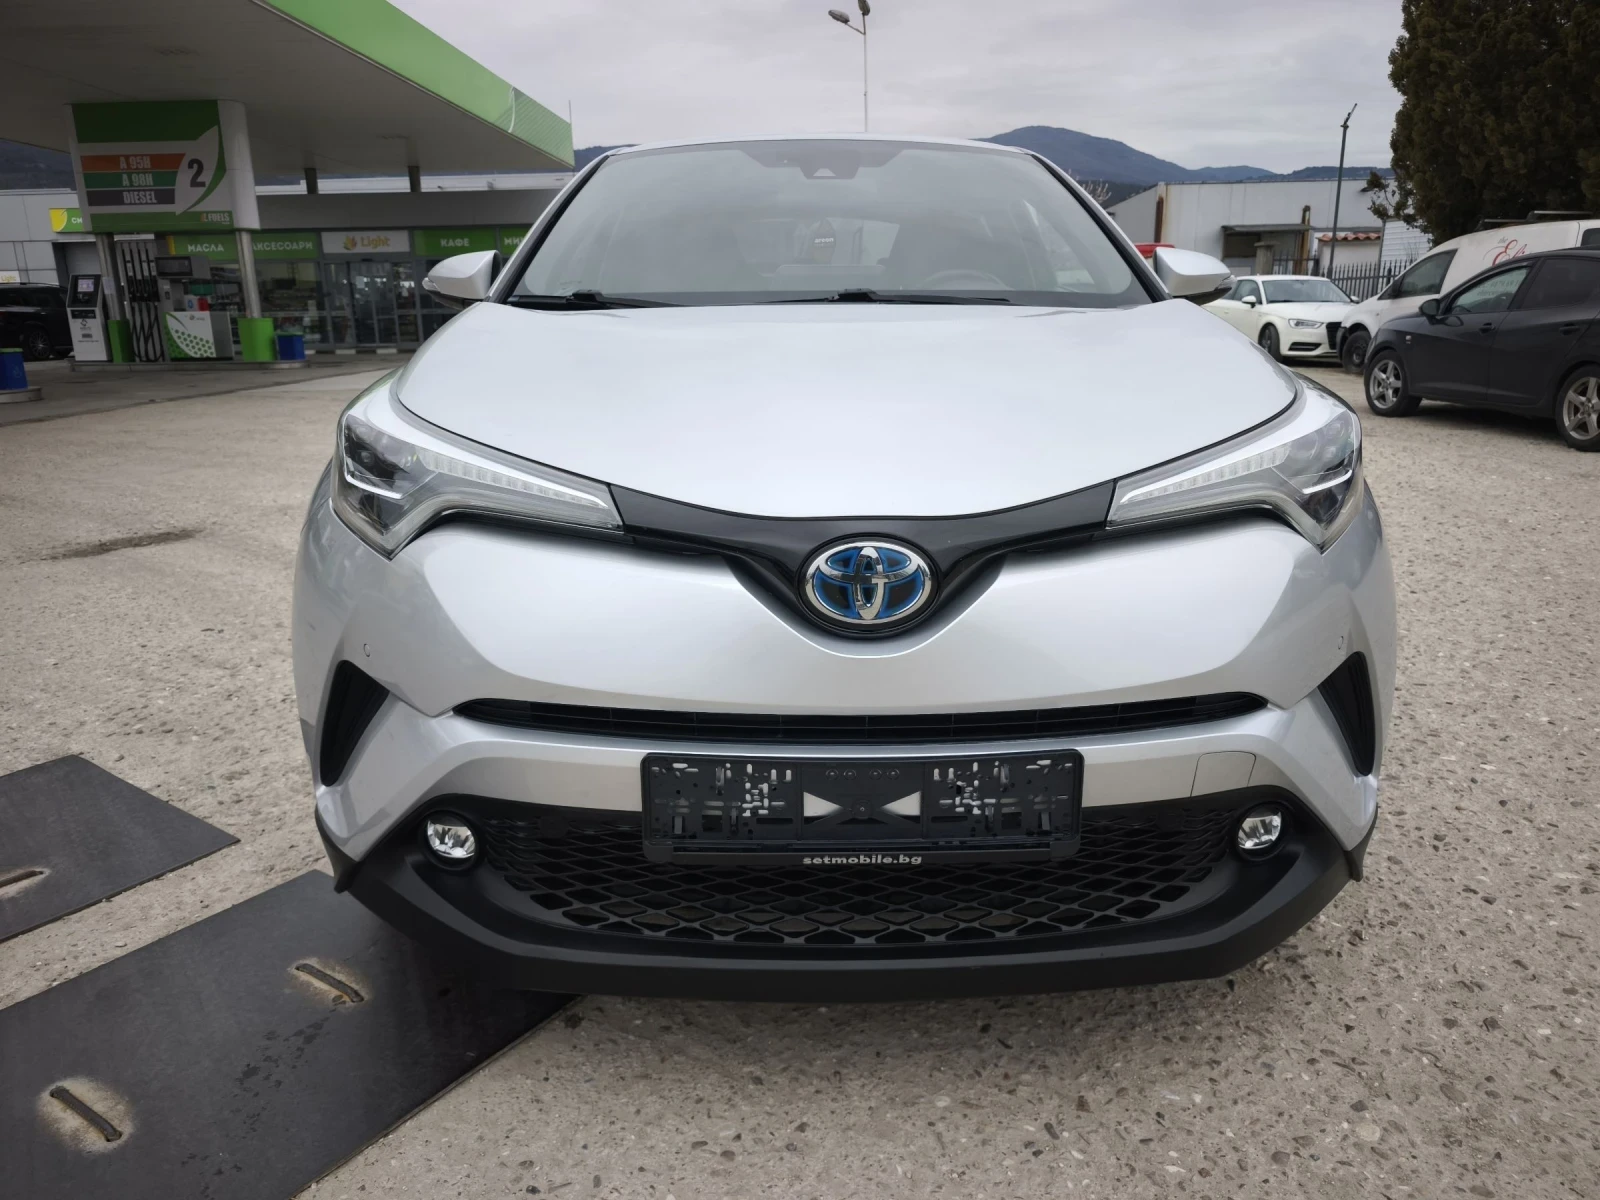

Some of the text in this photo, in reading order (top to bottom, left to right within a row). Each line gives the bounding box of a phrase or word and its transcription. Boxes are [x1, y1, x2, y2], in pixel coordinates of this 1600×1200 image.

[120, 156, 127, 169] A
[187, 158, 206, 188] 2
[122, 173, 130, 187] A
[122, 190, 158, 204] DIESEL
[187, 243, 225, 253] МАСЛА
[360, 236, 391, 249] Light
[440, 238, 470, 247] КАФЕ
[802, 854, 922, 865] setmobile.bg
